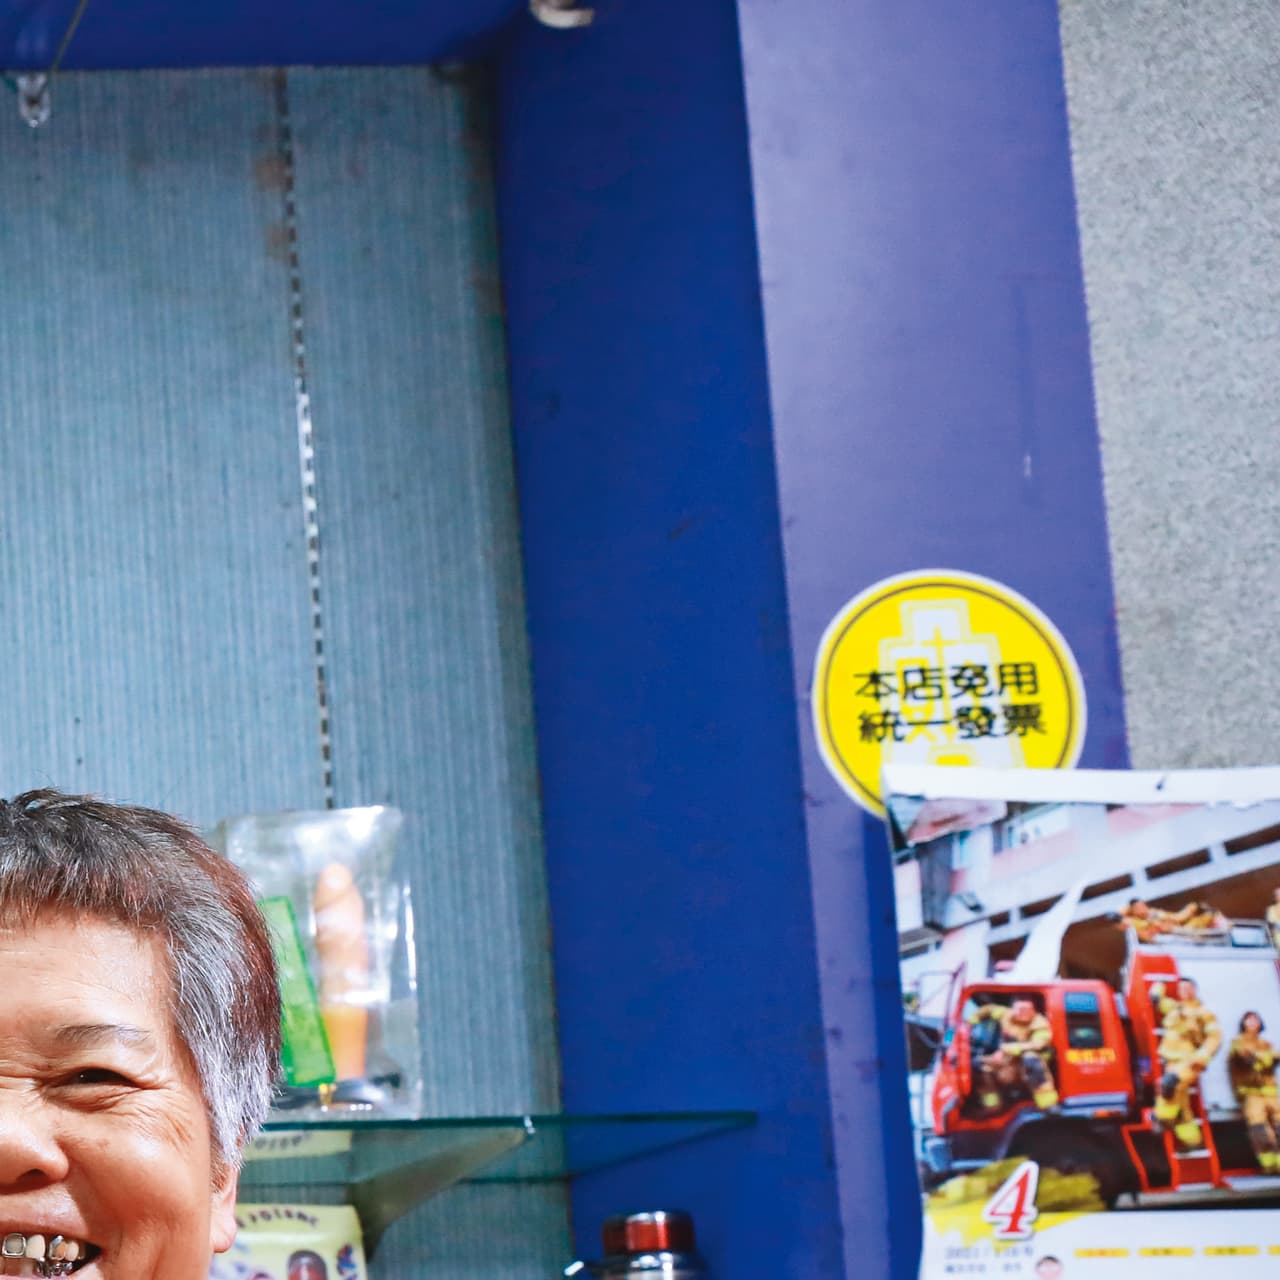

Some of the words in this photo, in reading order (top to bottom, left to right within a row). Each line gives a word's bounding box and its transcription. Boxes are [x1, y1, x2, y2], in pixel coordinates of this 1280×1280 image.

[853, 662, 1040, 702] 本店免用
[859, 703, 1047, 744] 統一發票
[990, 1168, 1032, 1235] 4
